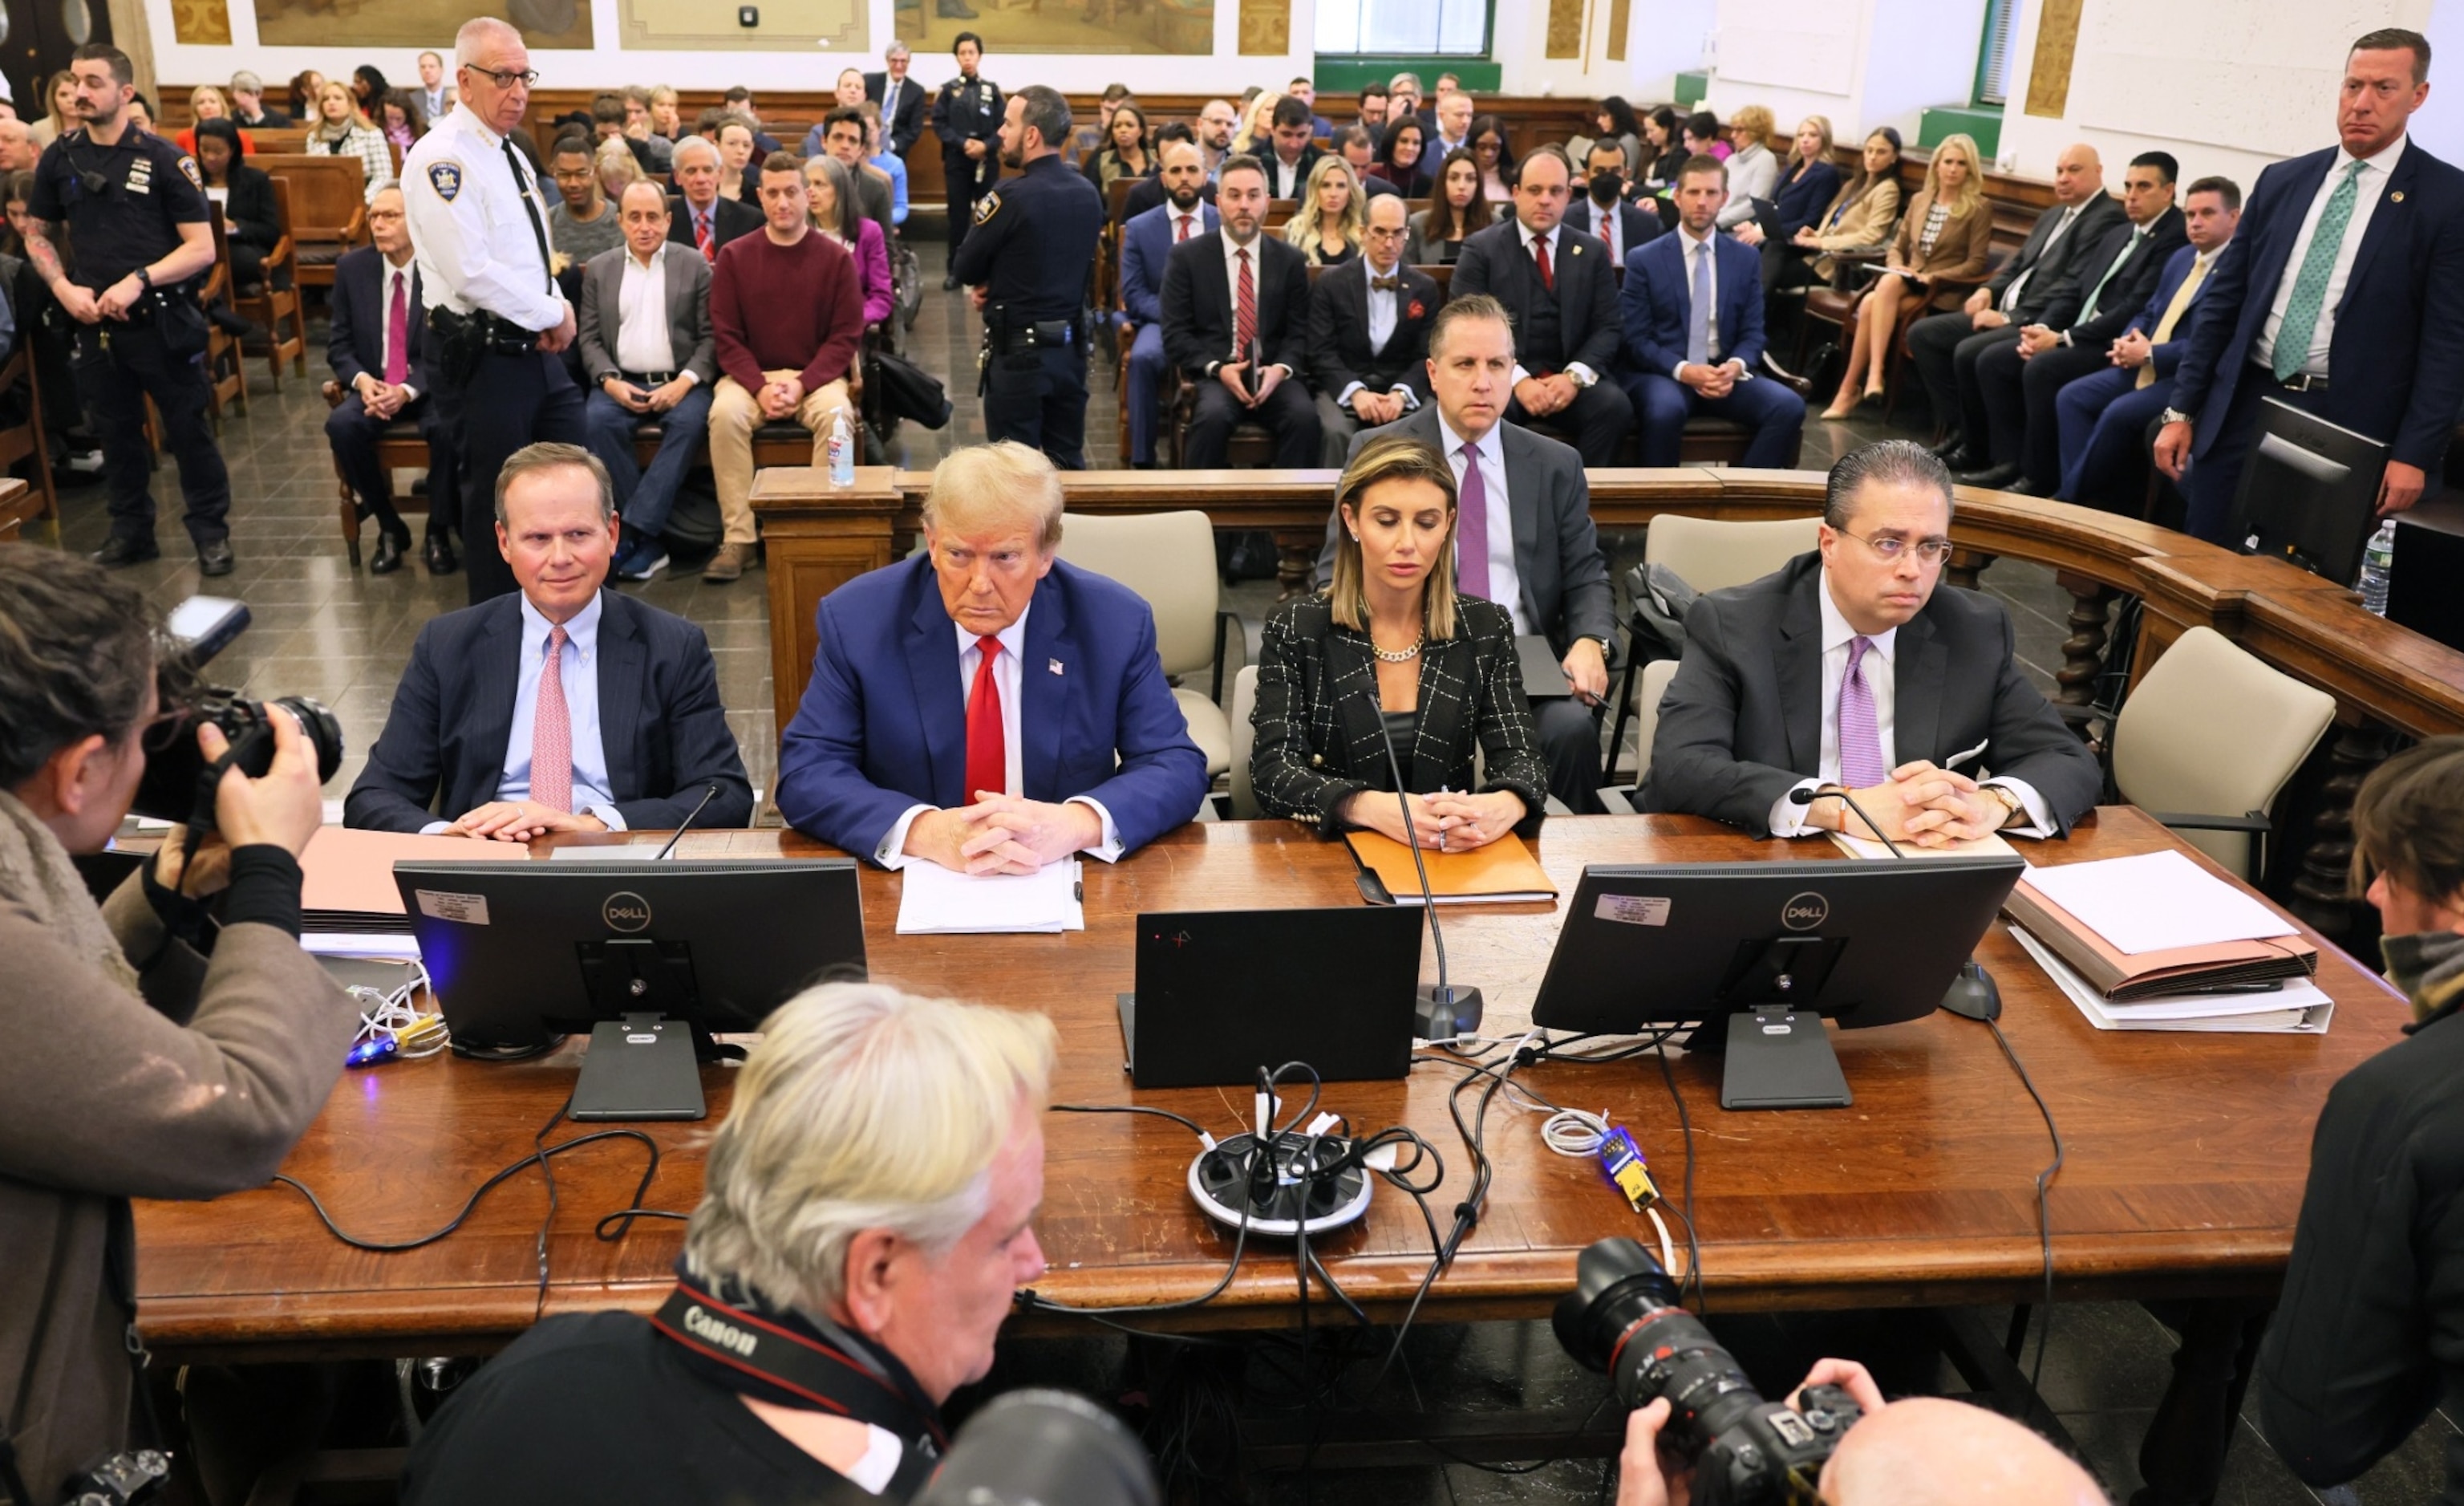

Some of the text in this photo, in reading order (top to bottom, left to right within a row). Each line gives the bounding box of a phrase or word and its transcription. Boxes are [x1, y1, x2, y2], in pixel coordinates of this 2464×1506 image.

[610, 907, 646, 919] DELL
[1787, 907, 1822, 918] DELL
[684, 1305, 758, 1357] Canon
